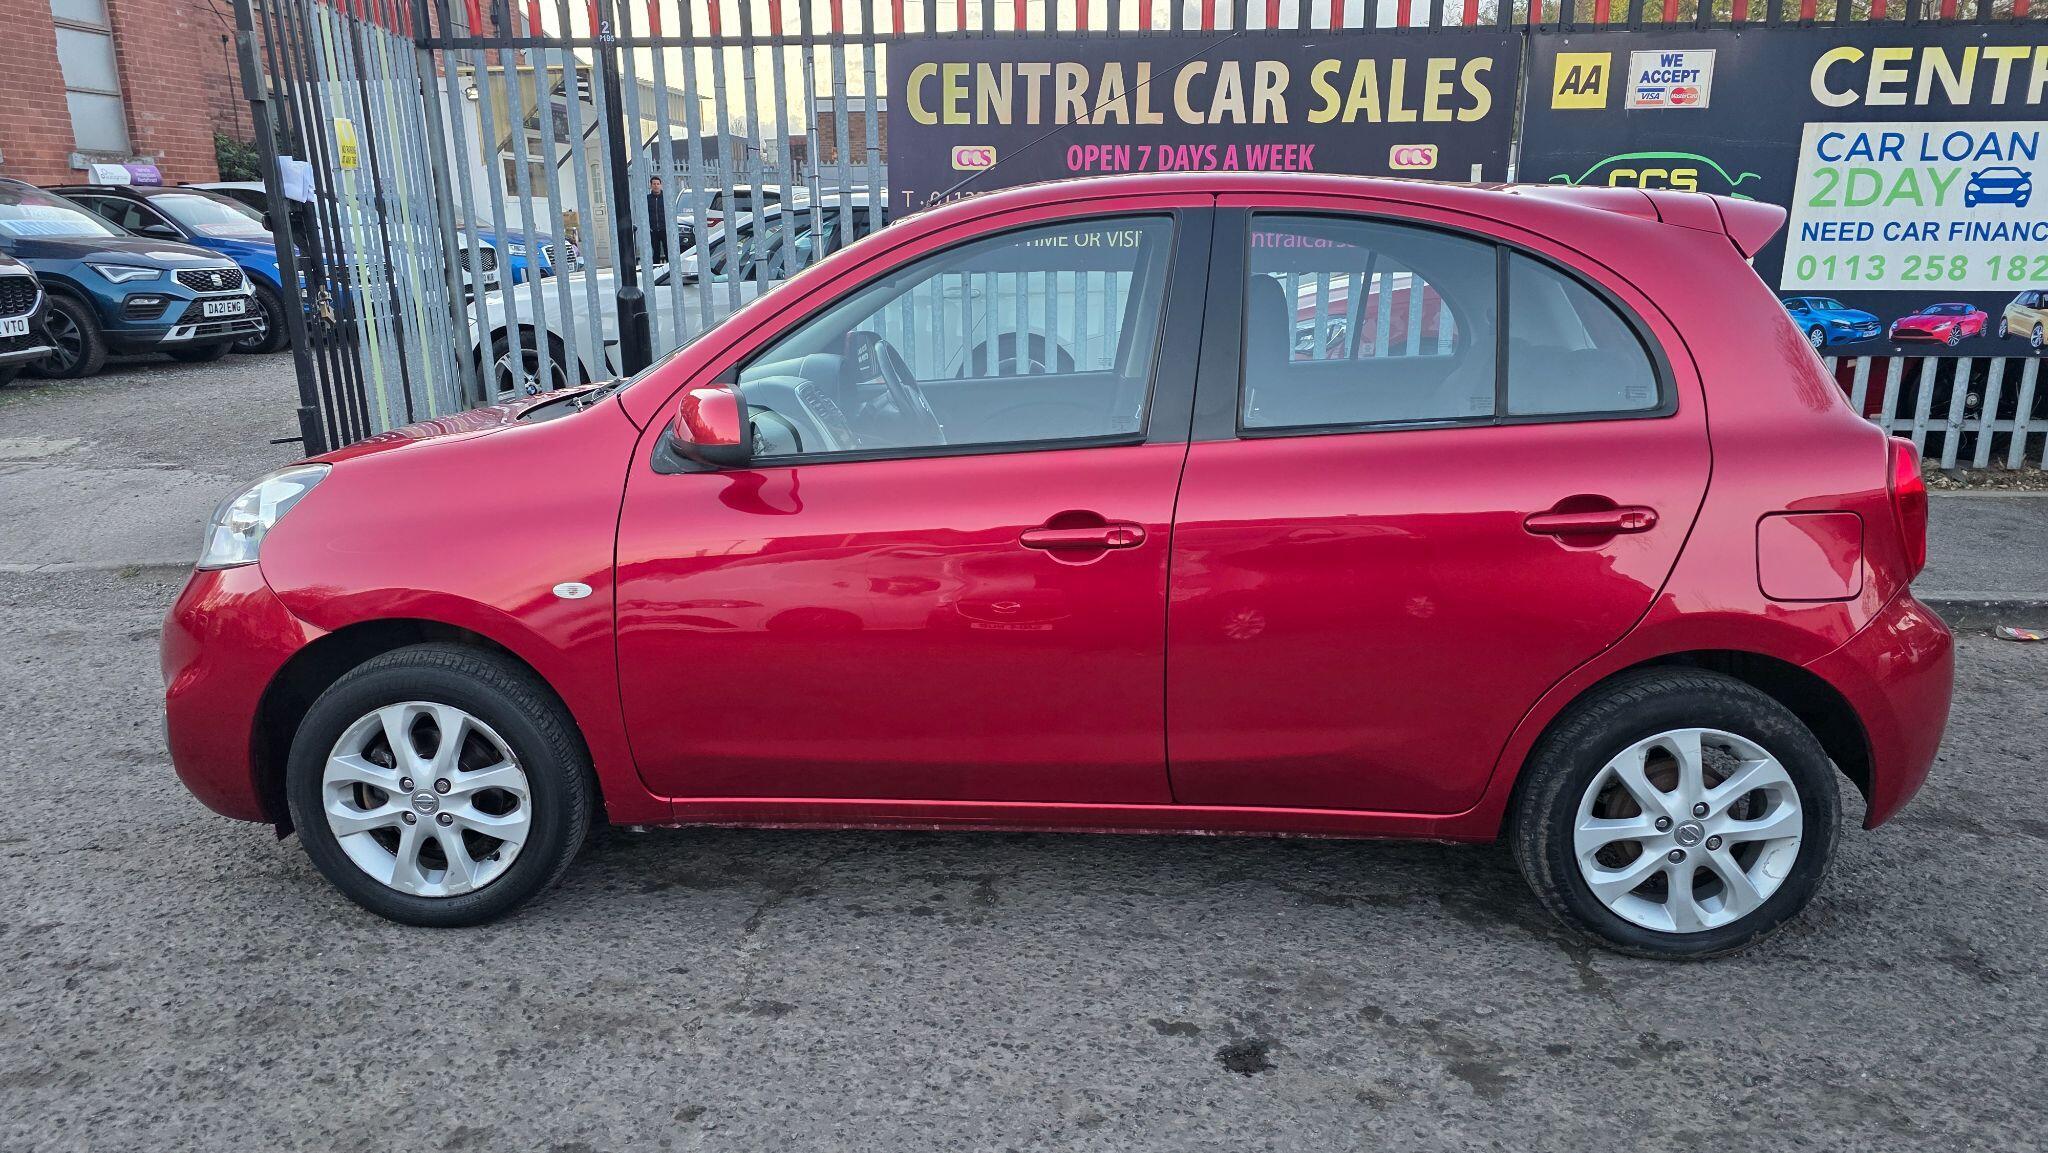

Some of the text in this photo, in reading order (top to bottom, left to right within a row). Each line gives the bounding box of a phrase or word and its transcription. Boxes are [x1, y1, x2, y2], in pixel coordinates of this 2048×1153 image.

[601, 20, 610, 34] 2
[1660, 53, 1684, 68] WE
[1558, 64, 1602, 96] AA
[1639, 69, 1701, 84] ACCEPT
[906, 56, 1494, 126] CENTRAL CAR SALES
[1641, 92, 1660, 100] VISA
[1066, 143, 1316, 172] OPEN 7 DAYS A WEEK
[1816, 130, 2040, 163] CAR LOAN
[1808, 166, 1963, 208] 2DAY
[1106, 230, 1143, 248] VISI
[1801, 221, 1875, 242] NEED
[1883, 220, 1940, 242] CAR
[1796, 254, 2048, 281] 0113 258 182
[208, 302, 226, 314] DA21
